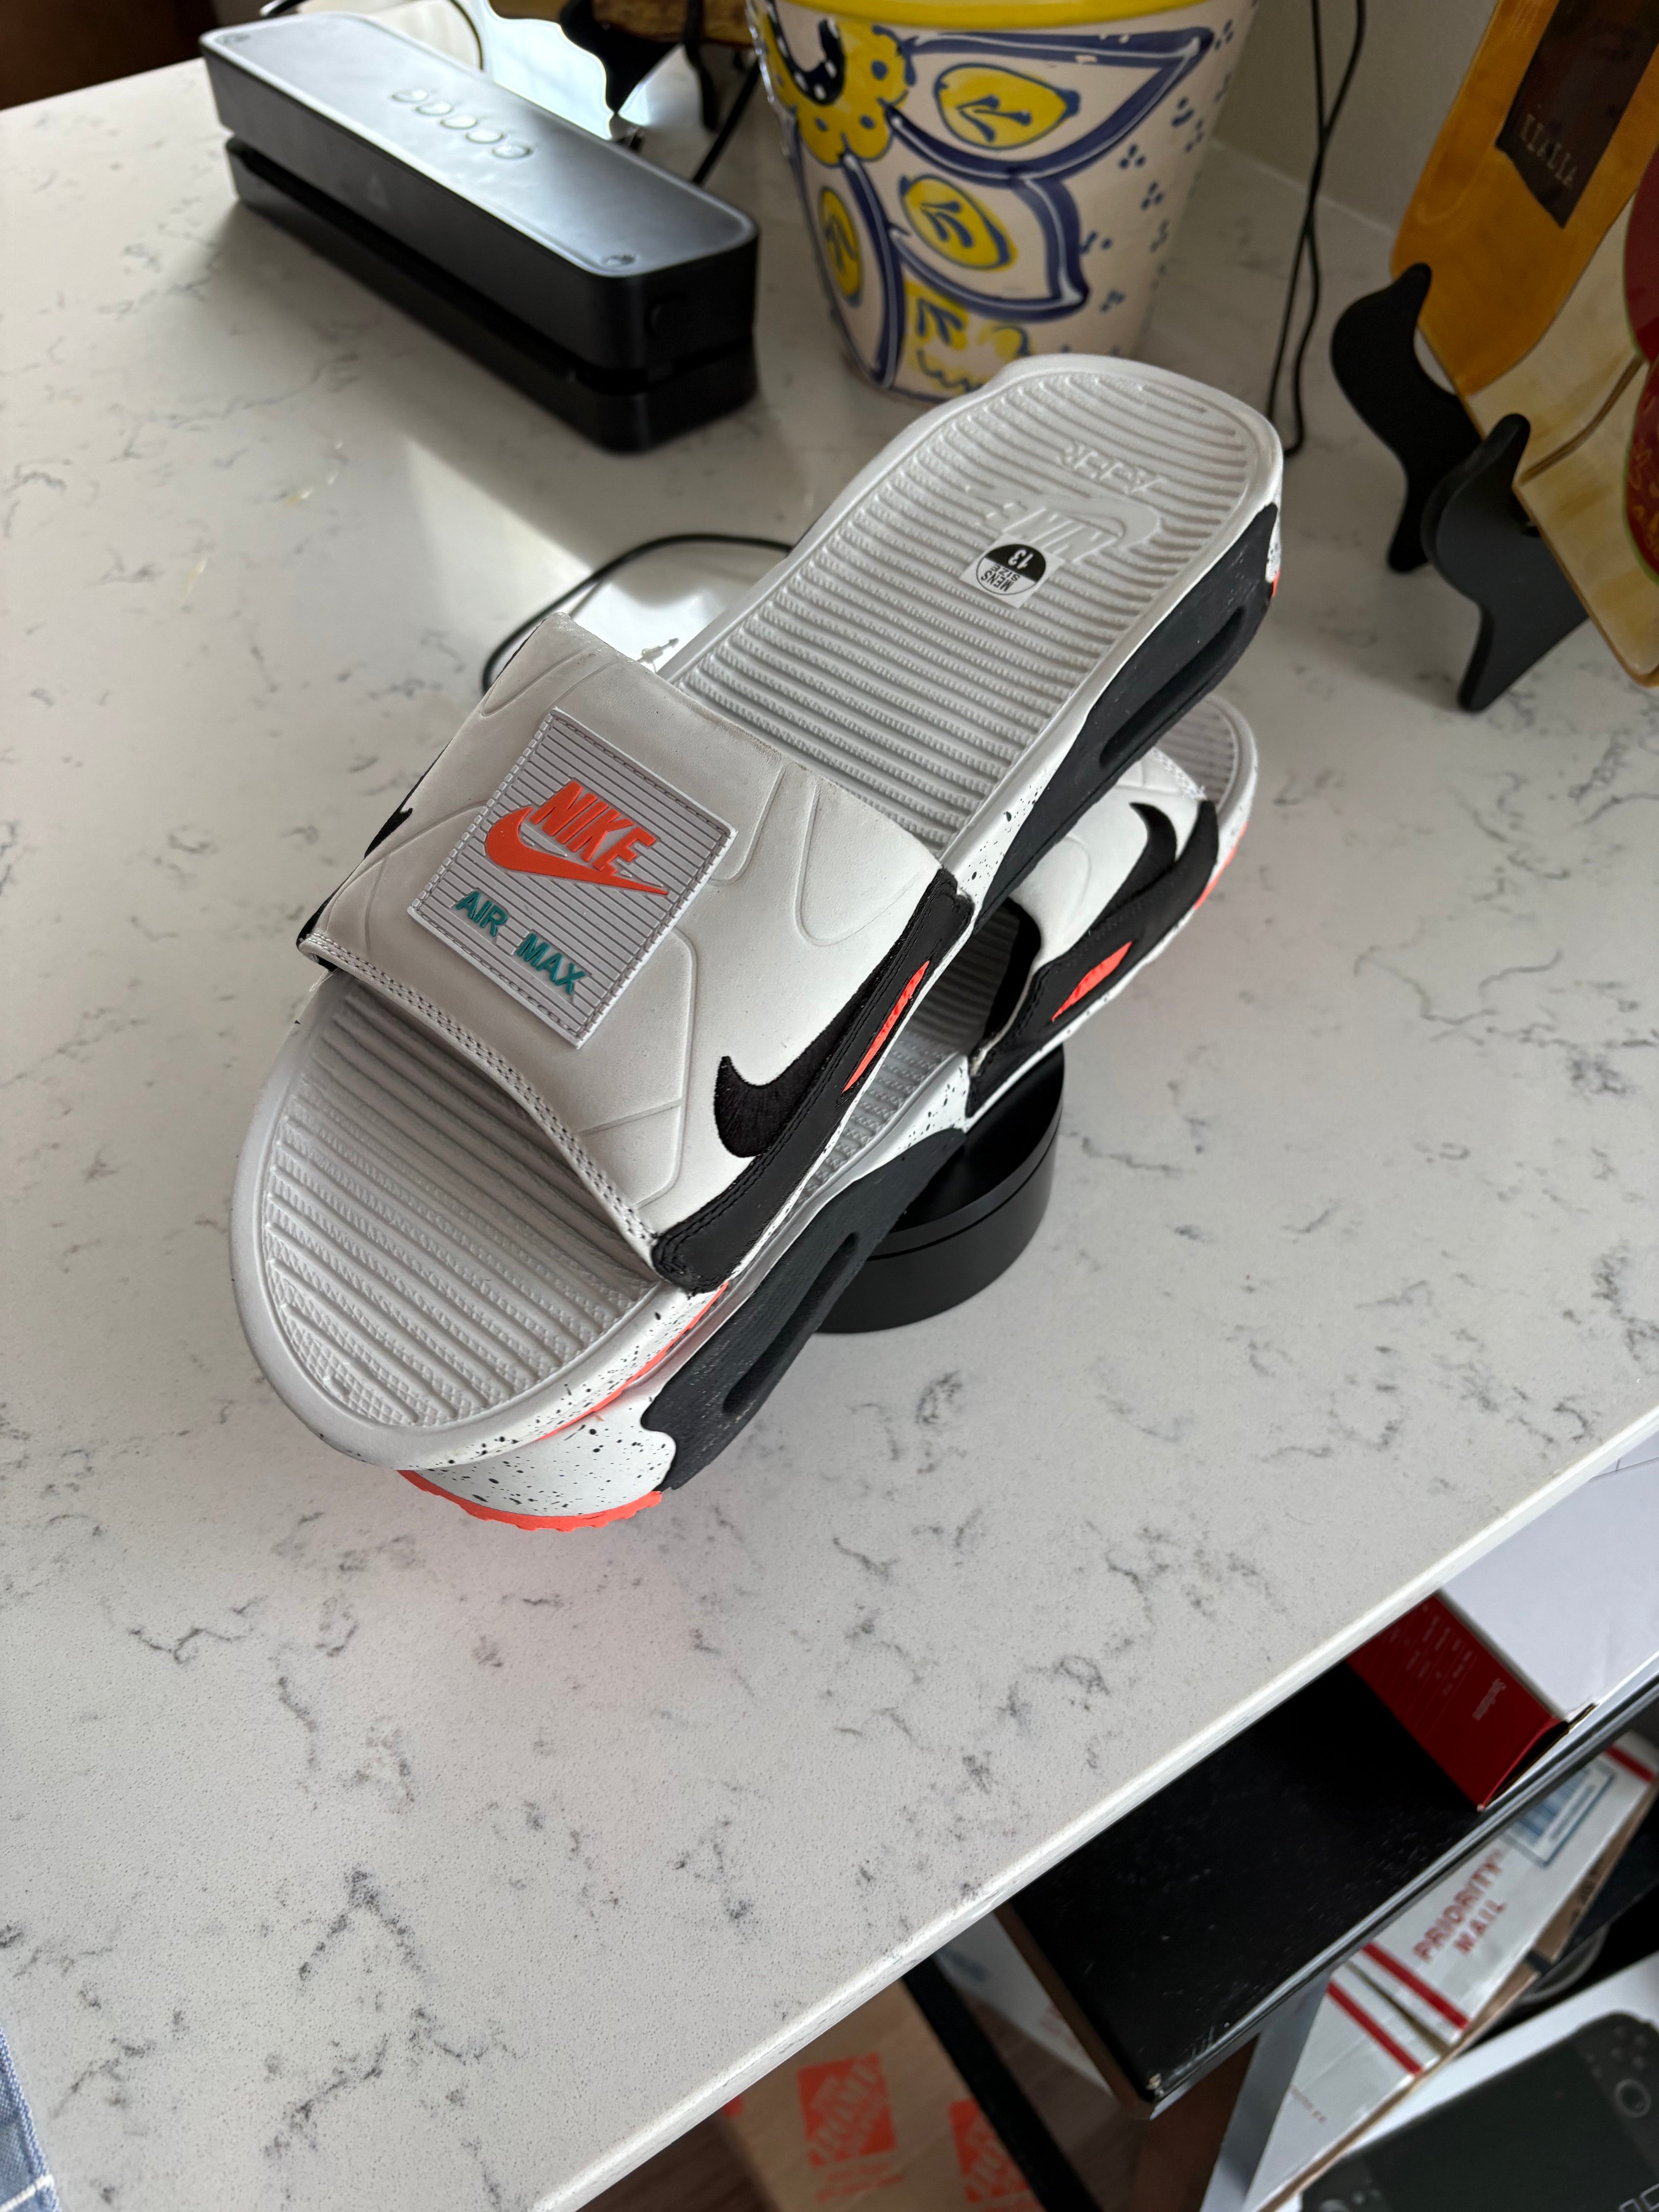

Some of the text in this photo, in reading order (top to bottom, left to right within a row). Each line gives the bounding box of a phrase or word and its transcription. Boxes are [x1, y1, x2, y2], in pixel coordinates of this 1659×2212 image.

[980, 570, 1014, 592] MENS
[990, 564, 1020, 582] SIZE
[1007, 548, 1034, 569] 13
[528, 781, 656, 873] NIKE
[455, 890, 586, 995] AIR MAX
[1412, 1856, 1503, 1963] PRIORITY
[1453, 1898, 1506, 1955] MAIL
